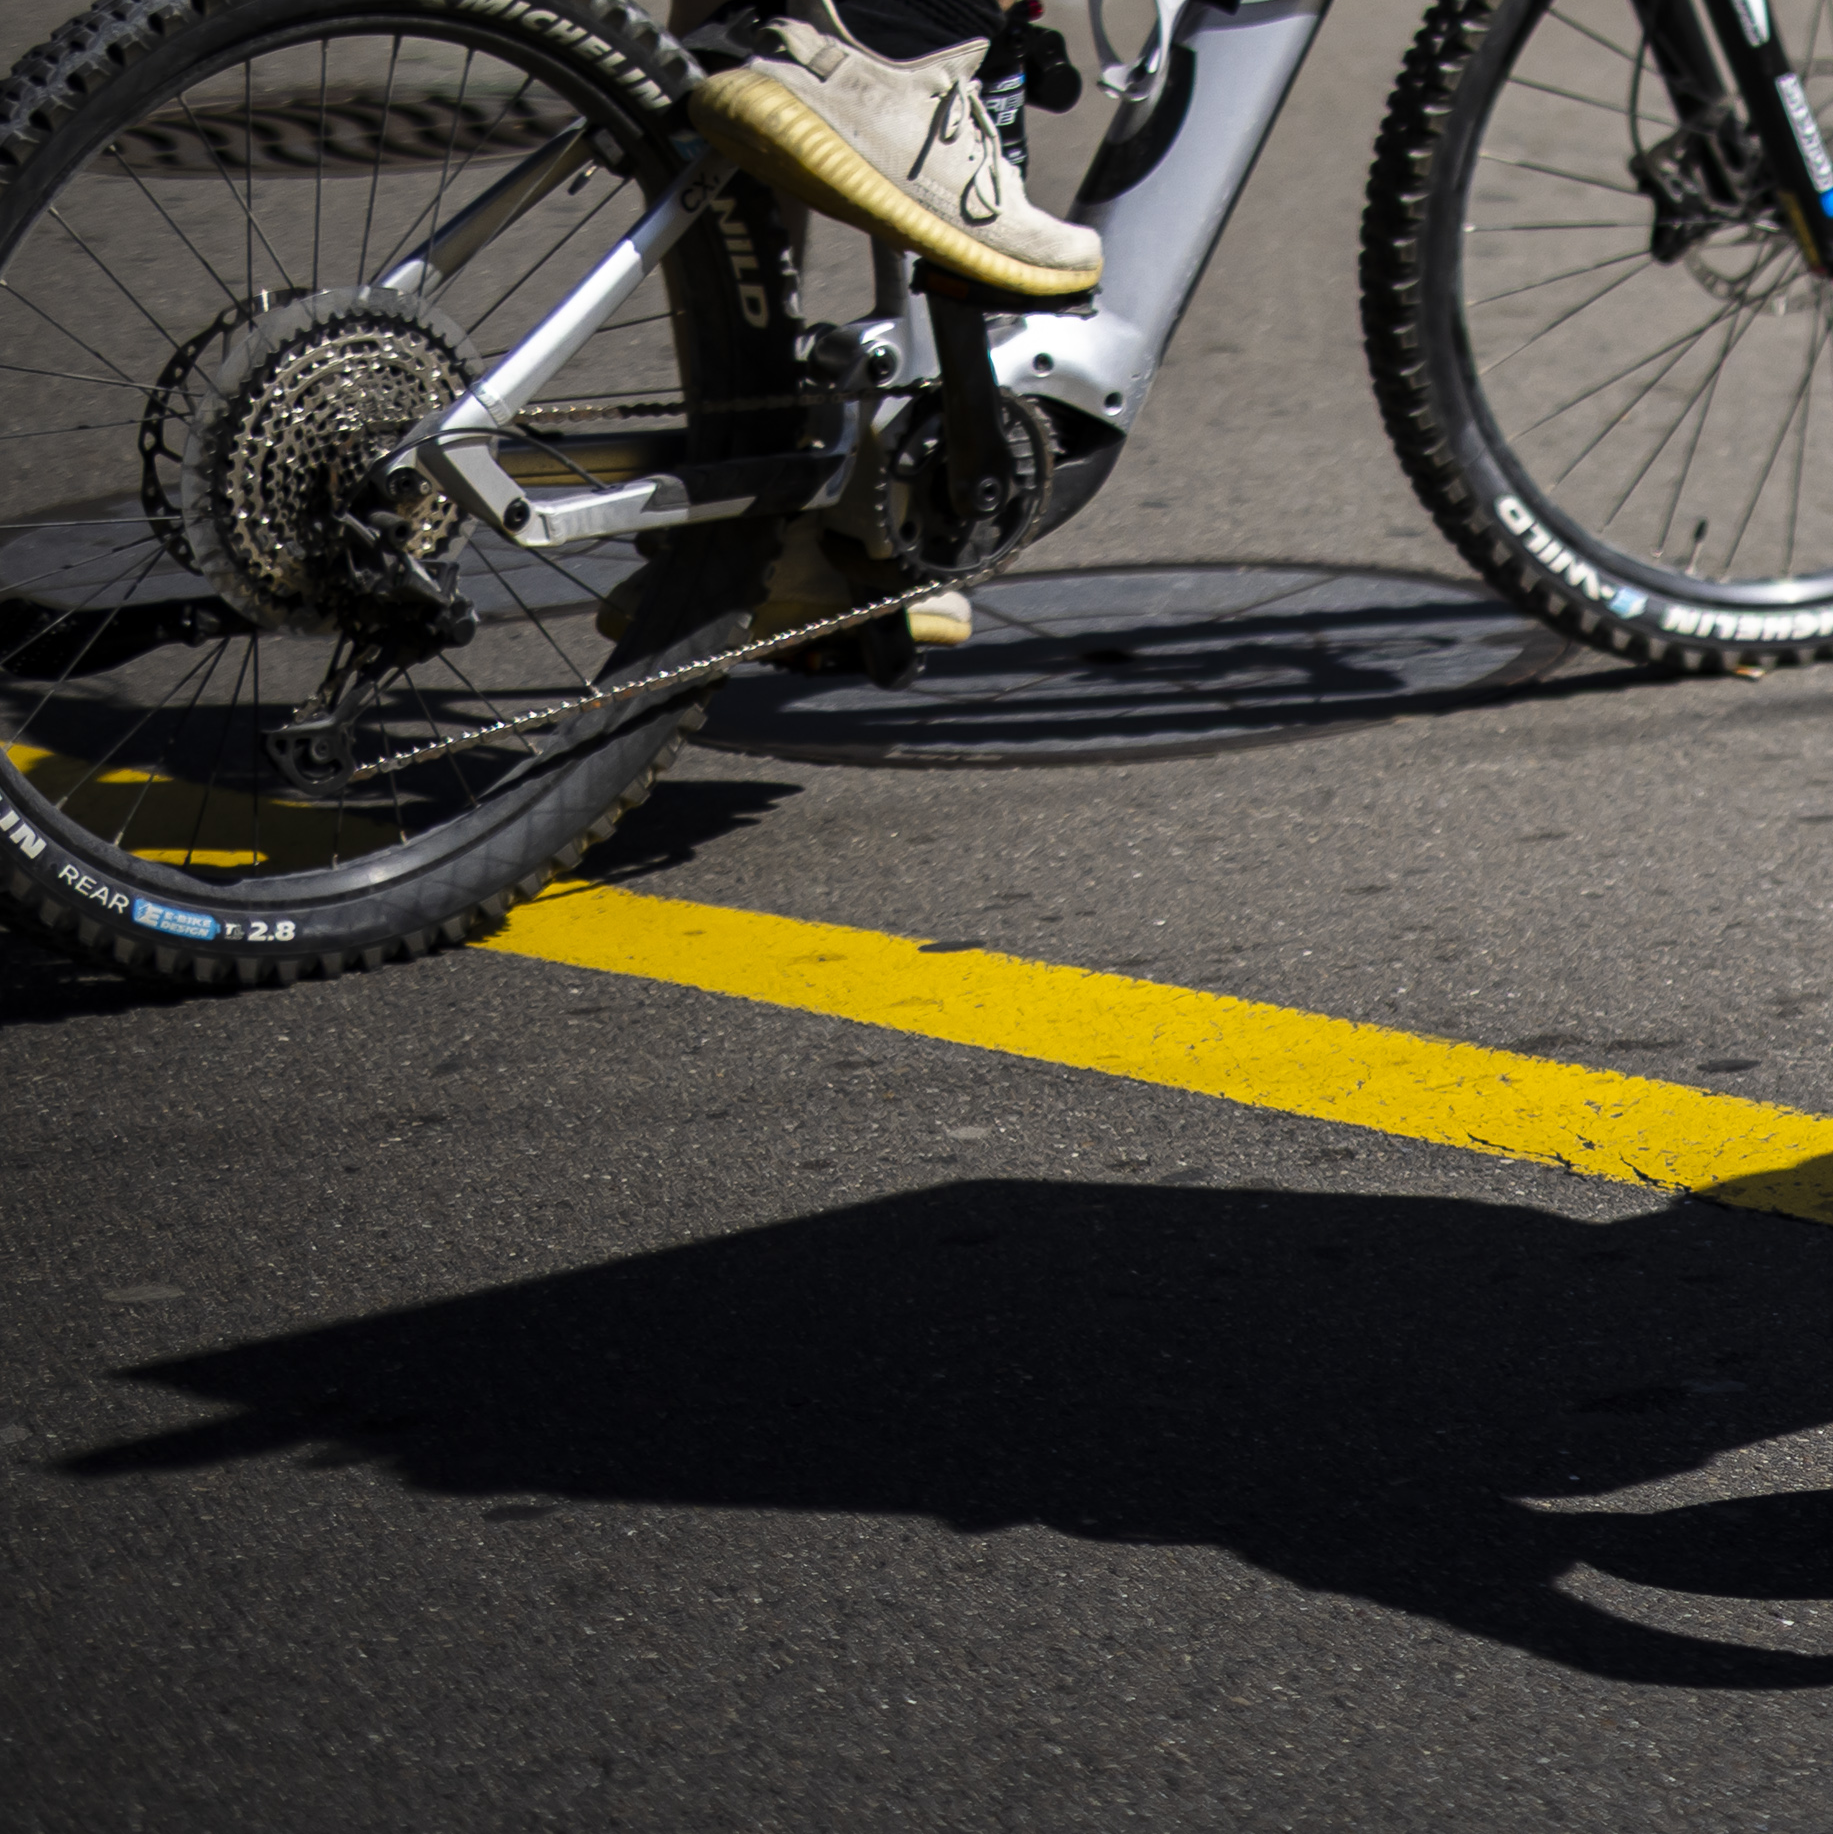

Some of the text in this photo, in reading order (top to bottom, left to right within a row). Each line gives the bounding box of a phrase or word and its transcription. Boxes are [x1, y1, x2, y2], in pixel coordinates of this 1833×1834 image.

[58, 863, 130, 914] REAR
[159, 920, 210, 938] DESIGN
[163, 910, 213, 929] E-BIKE
[247, 919, 297, 942] 2.8
